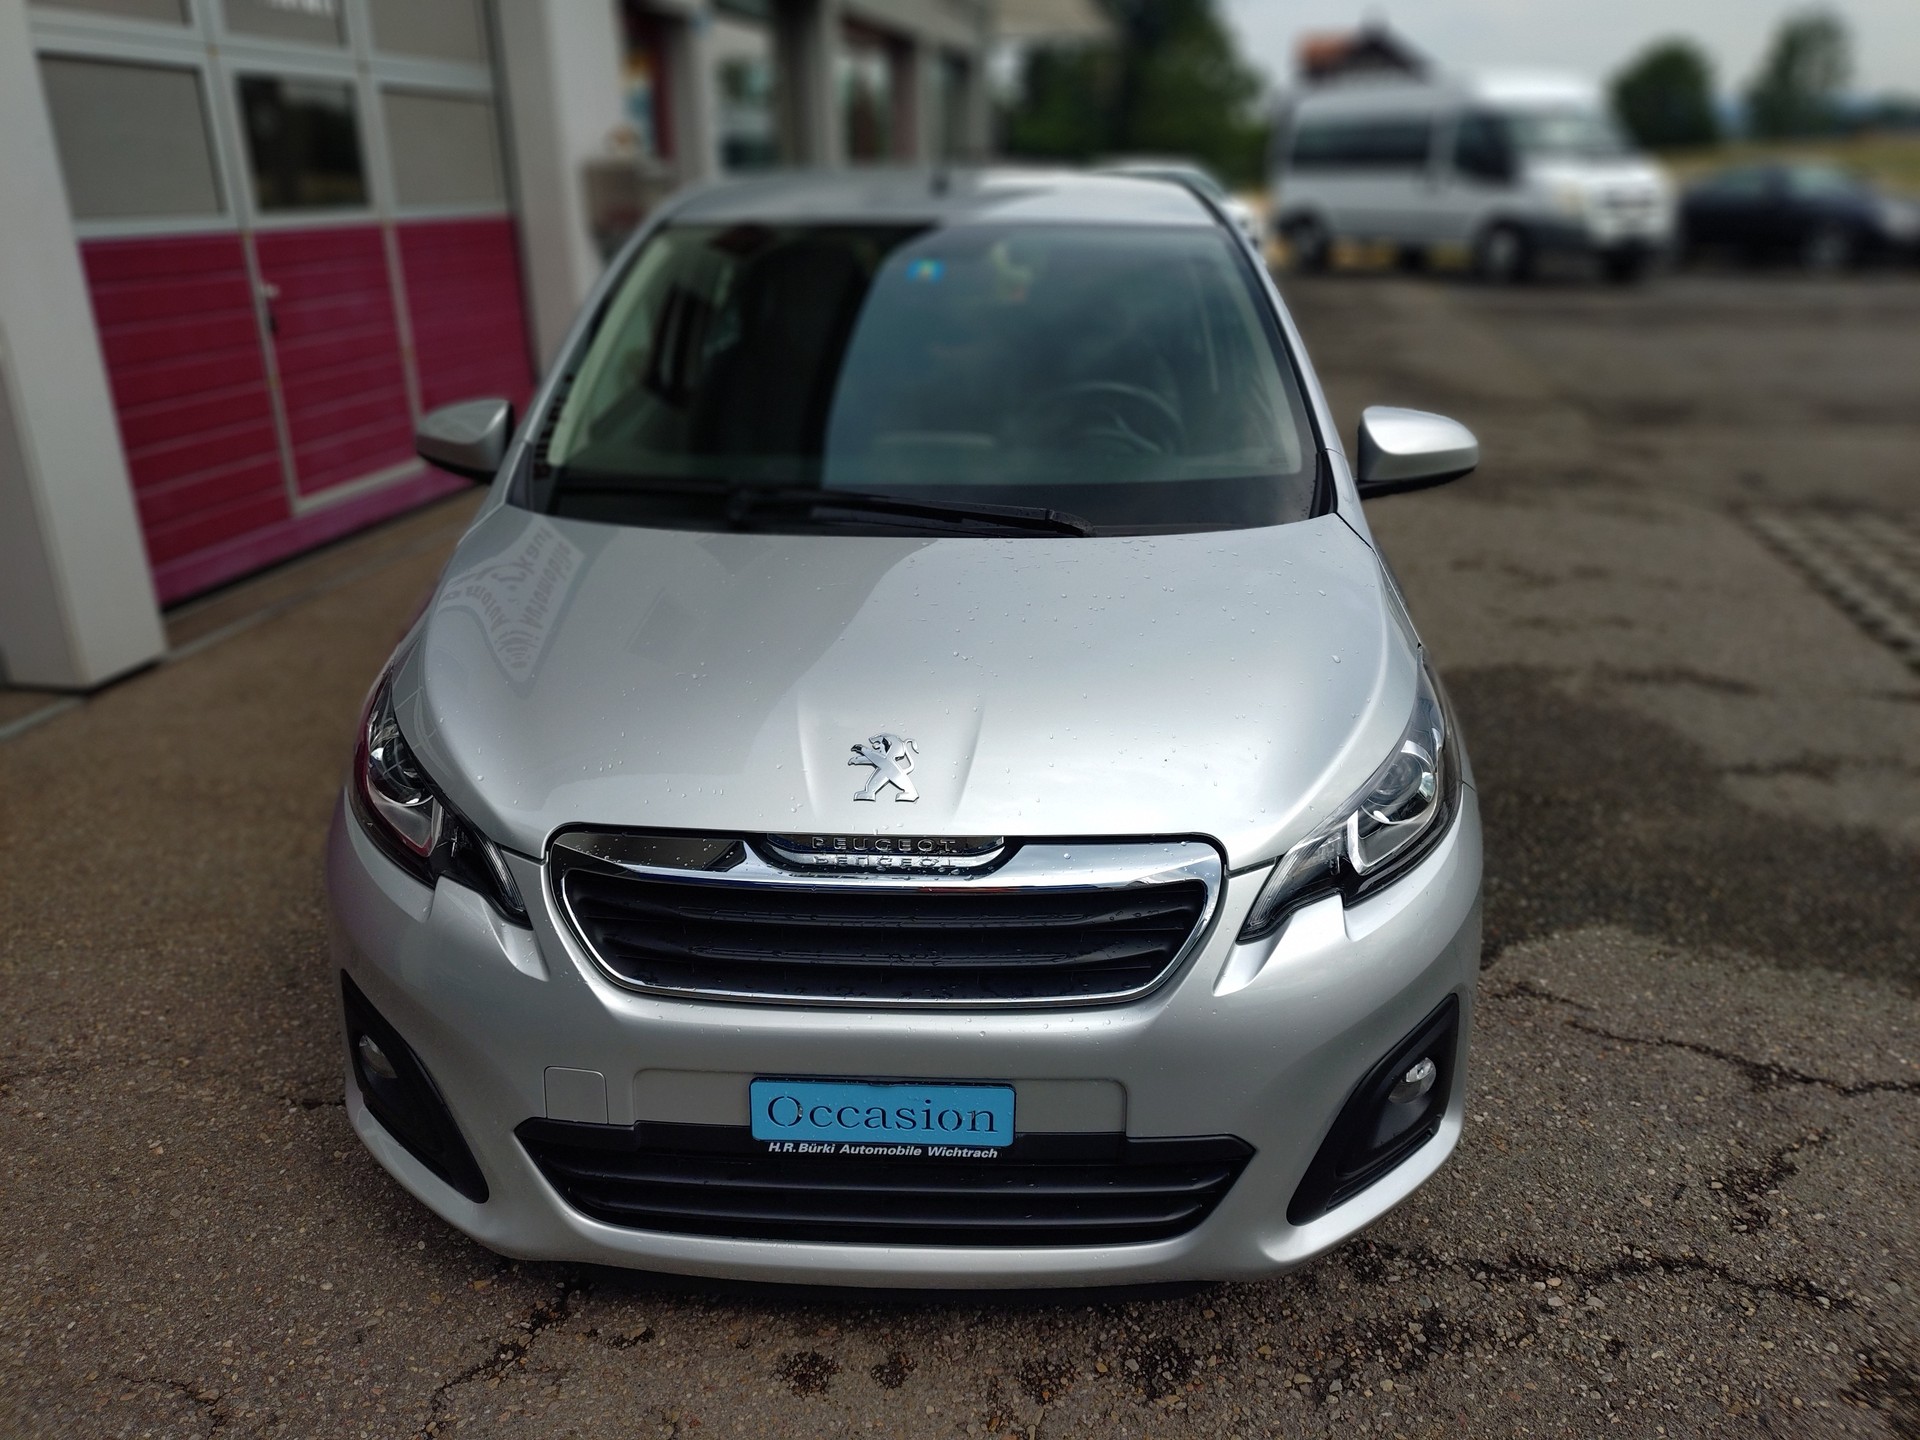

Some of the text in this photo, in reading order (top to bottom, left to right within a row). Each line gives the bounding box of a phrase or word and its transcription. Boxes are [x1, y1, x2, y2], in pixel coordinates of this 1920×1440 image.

[811, 836, 956, 851] PEUGEOT
[767, 1095, 999, 1132] Occasion
[839, 1144, 922, 1156] Automobile
[928, 1146, 998, 1159] Wichtrach
